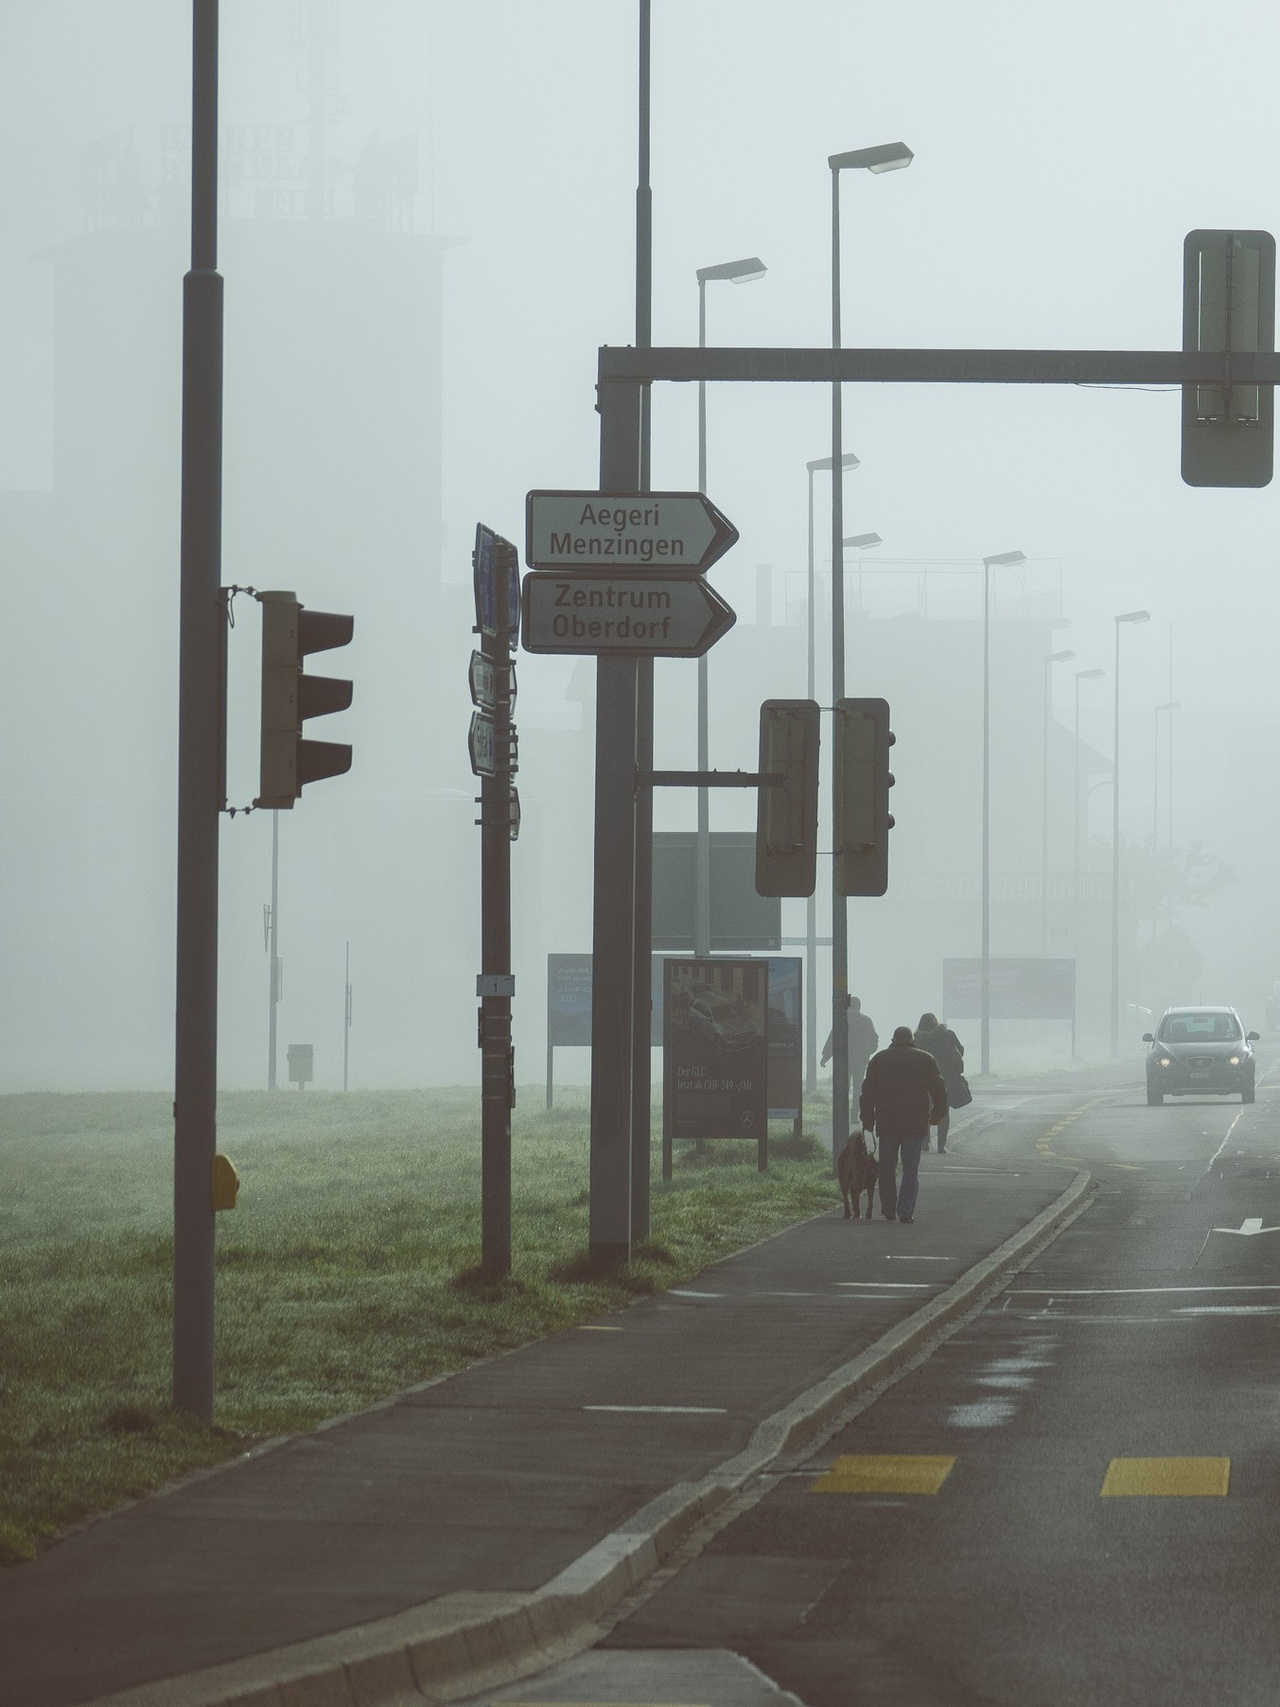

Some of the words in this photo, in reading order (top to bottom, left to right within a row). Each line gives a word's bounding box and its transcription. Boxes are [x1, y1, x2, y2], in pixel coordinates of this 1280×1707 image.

[158, 123, 298, 152] BRER
[579, 503, 659, 531] Aegeri
[550, 532, 684, 561] Menzingen
[554, 584, 671, 608] Zentrum
[552, 614, 671, 639] Oberdorf
[677, 1066, 691, 1077] Der
[677, 1079, 693, 1090] Jetzt
[694, 1079, 703, 1090] ab
[703, 1079, 719, 1090] CHF
